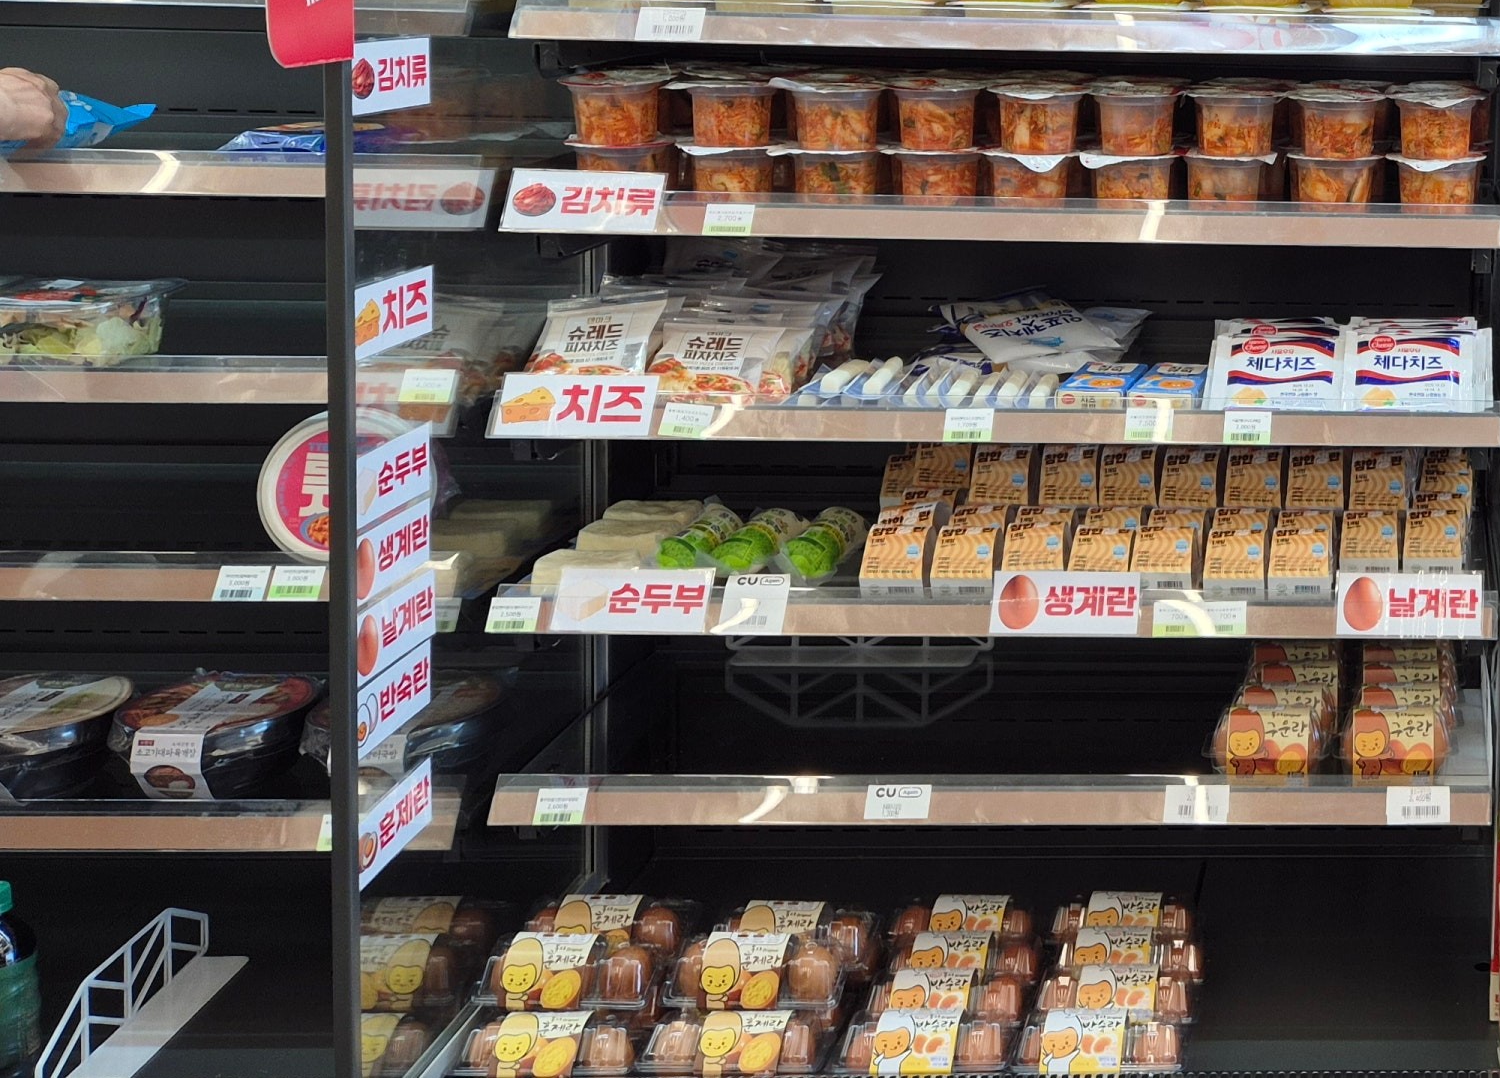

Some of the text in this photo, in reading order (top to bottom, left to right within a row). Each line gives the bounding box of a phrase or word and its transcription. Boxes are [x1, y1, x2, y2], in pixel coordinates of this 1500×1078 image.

[377, 53, 428, 92] 김치류
[560, 186, 656, 216] 김치류
[383, 279, 428, 334] 치즈
[567, 323, 624, 342] 슈레드
[564, 339, 620, 353] 피자치즈
[687, 335, 744, 351] 슈레드
[682, 349, 738, 362] 피자치즈
[1246, 355, 1316, 373] 체다치즈
[1373, 354, 1444, 372] 체다치즈
[556, 384, 646, 424] 치즈
[377, 442, 428, 498] 순두부
[377, 510, 429, 572] 생계란
[737, 576, 758, 586] CU
[608, 582, 706, 615] 순두부
[1044, 585, 1138, 618] 생계란
[1388, 586, 1479, 620] 날계란
[381, 585, 434, 650] 날계란
[379, 656, 430, 721] 반숙란
[1265, 719, 1309, 738] 구운란
[1390, 718, 1433, 738] 구운란
[876, 787, 897, 798] CU
[378, 777, 431, 851] 훈제란
[967, 901, 1003, 916] 반숙란
[1122, 899, 1158, 914] 반숙란
[592, 911, 632, 929] 훈제란
[777, 915, 814, 934] 훈제란
[950, 935, 986, 952] 반숙란
[1111, 934, 1148, 950] 반숙란
[542, 951, 584, 969] 훈제란
[740, 951, 782, 969] 훈제란
[931, 974, 968, 989] 반숙란
[1116, 972, 1154, 988] 반숙란
[538, 1016, 581, 1036] 훈제란
[745, 1016, 786, 1036] 훈제란
[915, 1018, 956, 1034] 반숙란
[1083, 1018, 1121, 1034] 반숙란
